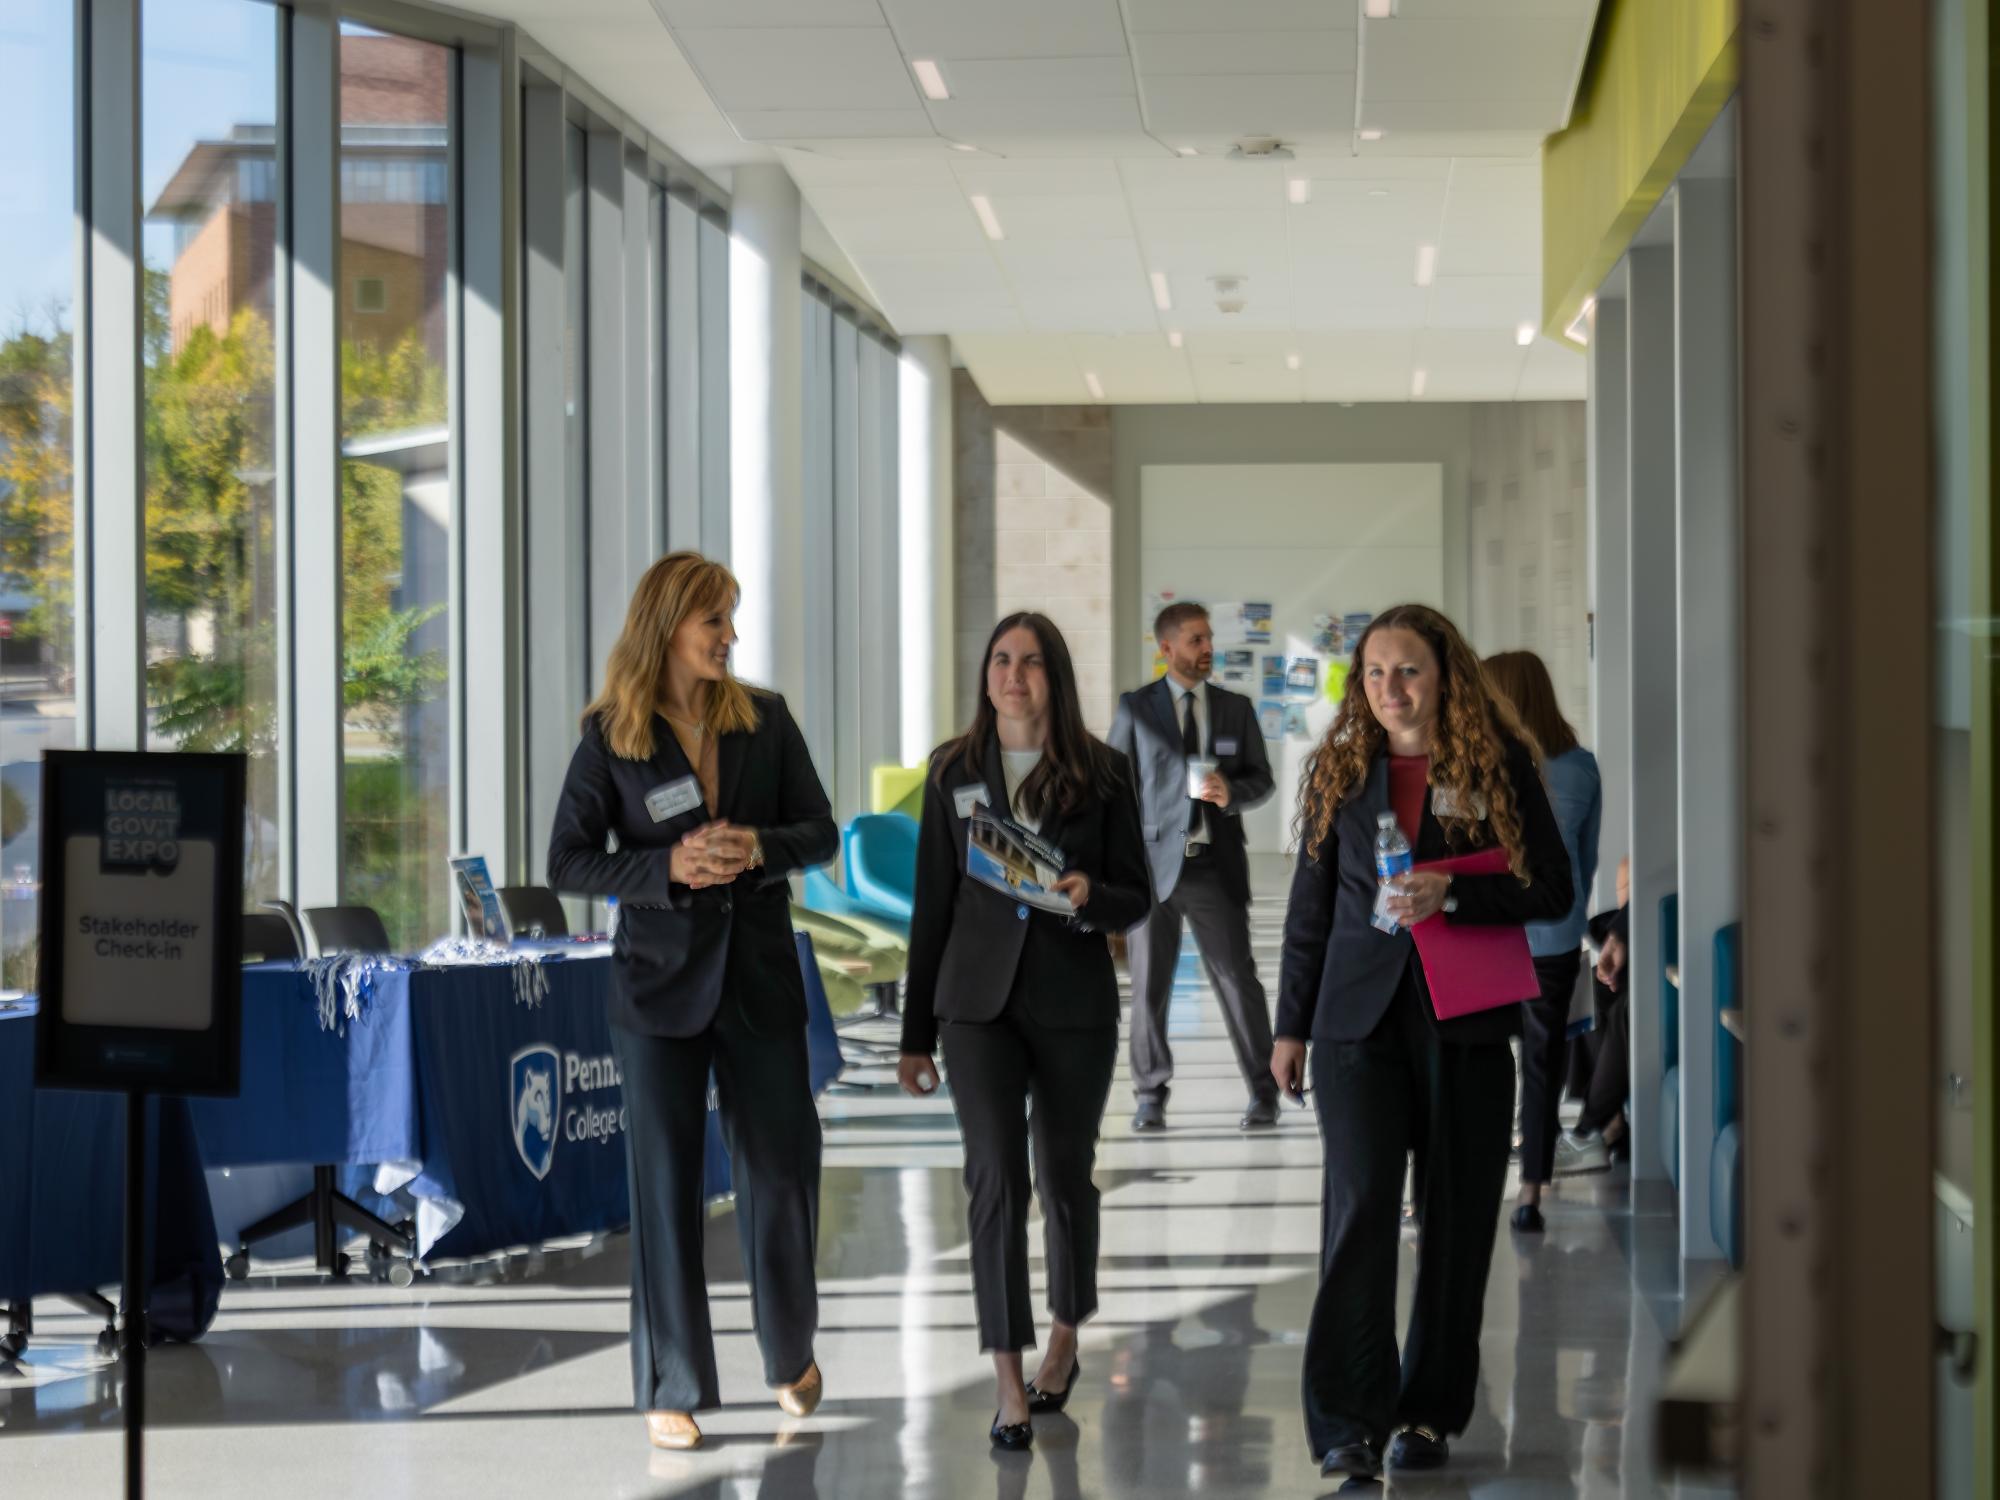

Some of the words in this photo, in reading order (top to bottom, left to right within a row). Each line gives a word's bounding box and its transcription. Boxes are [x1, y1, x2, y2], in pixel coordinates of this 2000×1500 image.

[106, 789, 178, 812] LOCAL
[106, 838, 178, 862] EXPO
[79, 915, 200, 939] Stakeholder
[95, 938, 182, 961] Check-in
[566, 1104, 617, 1145] College
